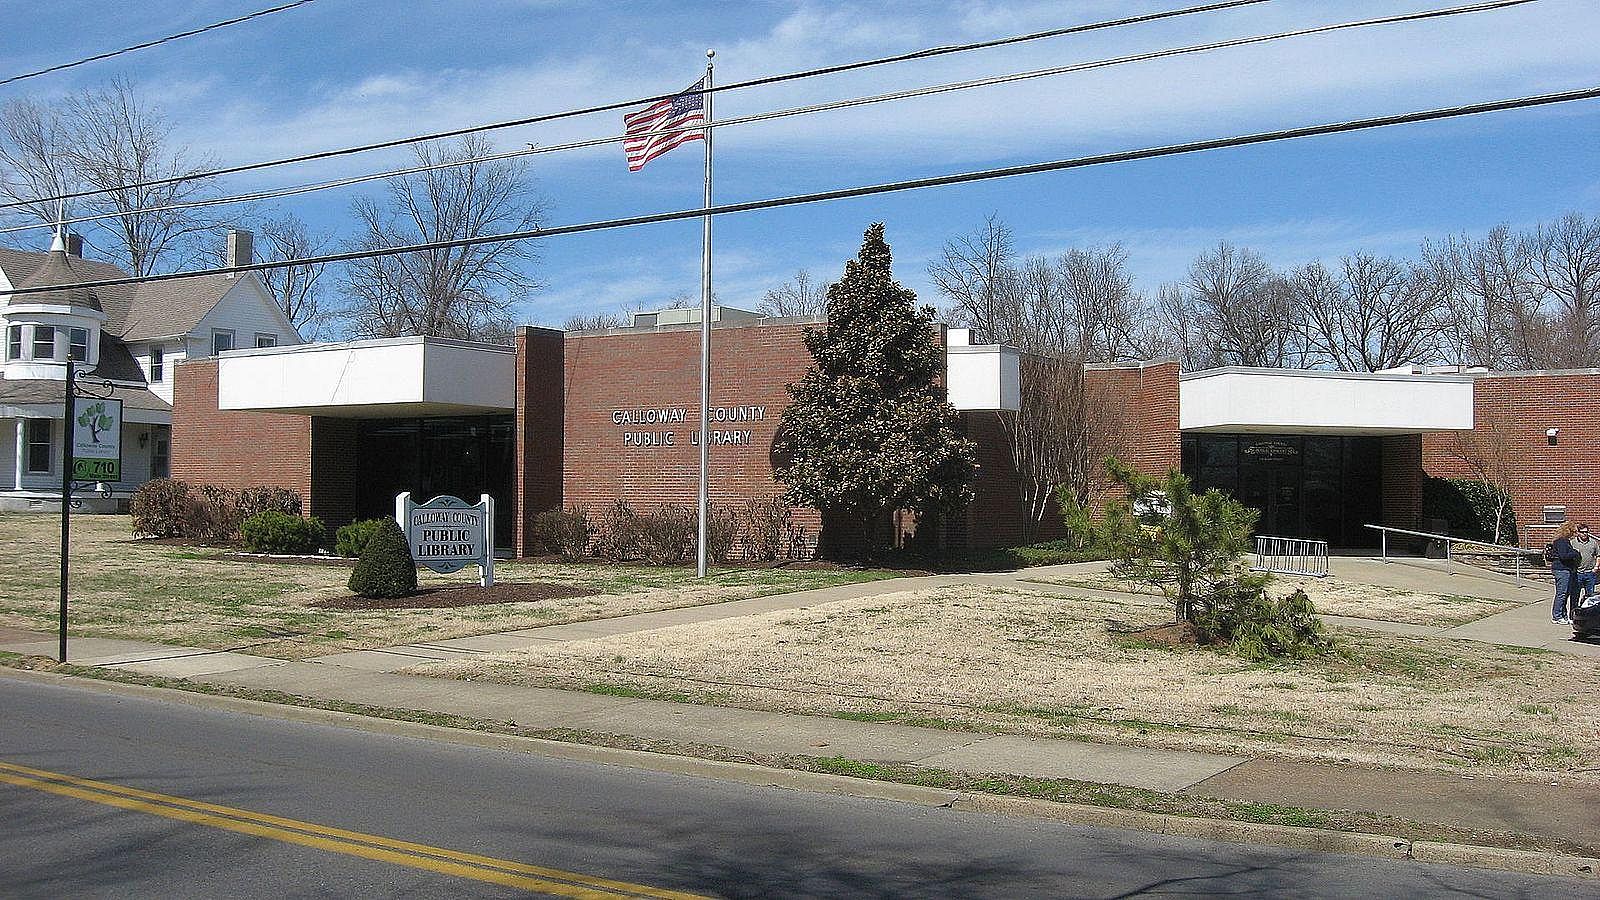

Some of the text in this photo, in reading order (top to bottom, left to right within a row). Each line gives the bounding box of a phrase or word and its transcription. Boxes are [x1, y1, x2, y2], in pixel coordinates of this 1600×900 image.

[612, 408, 687, 424] CALLOWAY
[624, 430, 752, 446] PUBLIC LIRARY
[93, 461, 115, 474] 710
[413, 511, 480, 527] CALLOWAY COUNTY
[423, 529, 471, 542] PUBLIC
[417, 543, 475, 556] LIBRARY
